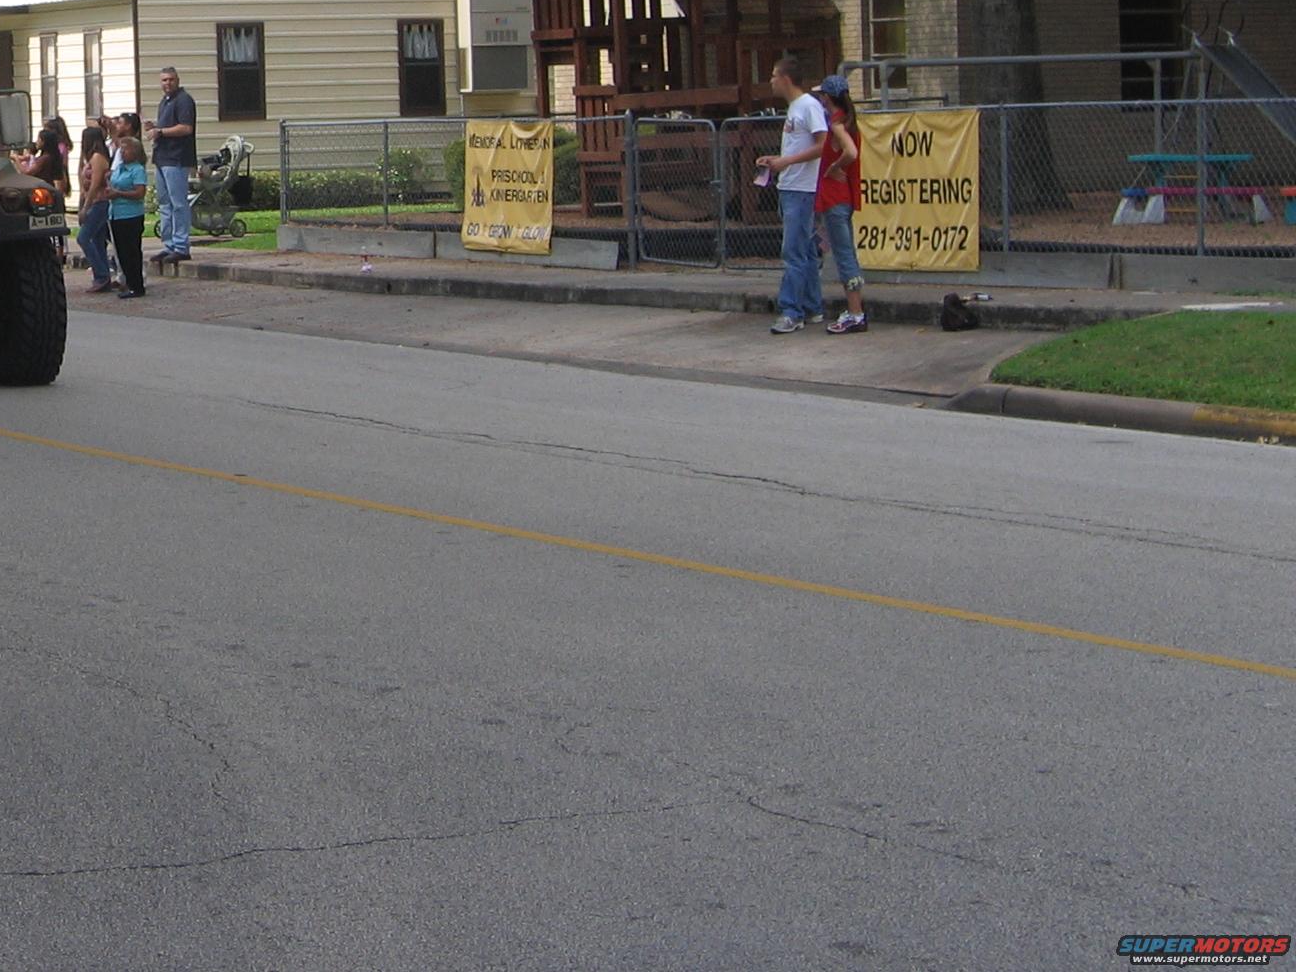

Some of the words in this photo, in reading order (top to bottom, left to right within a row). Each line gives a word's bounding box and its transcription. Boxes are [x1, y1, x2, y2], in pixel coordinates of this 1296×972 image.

[469, 133, 506, 149] MEMORAL
[891, 131, 934, 157] NOW
[861, 178, 972, 205] REGISTERING
[467, 222, 480, 237] GO
[857, 225, 969, 251] 281-391-0172
